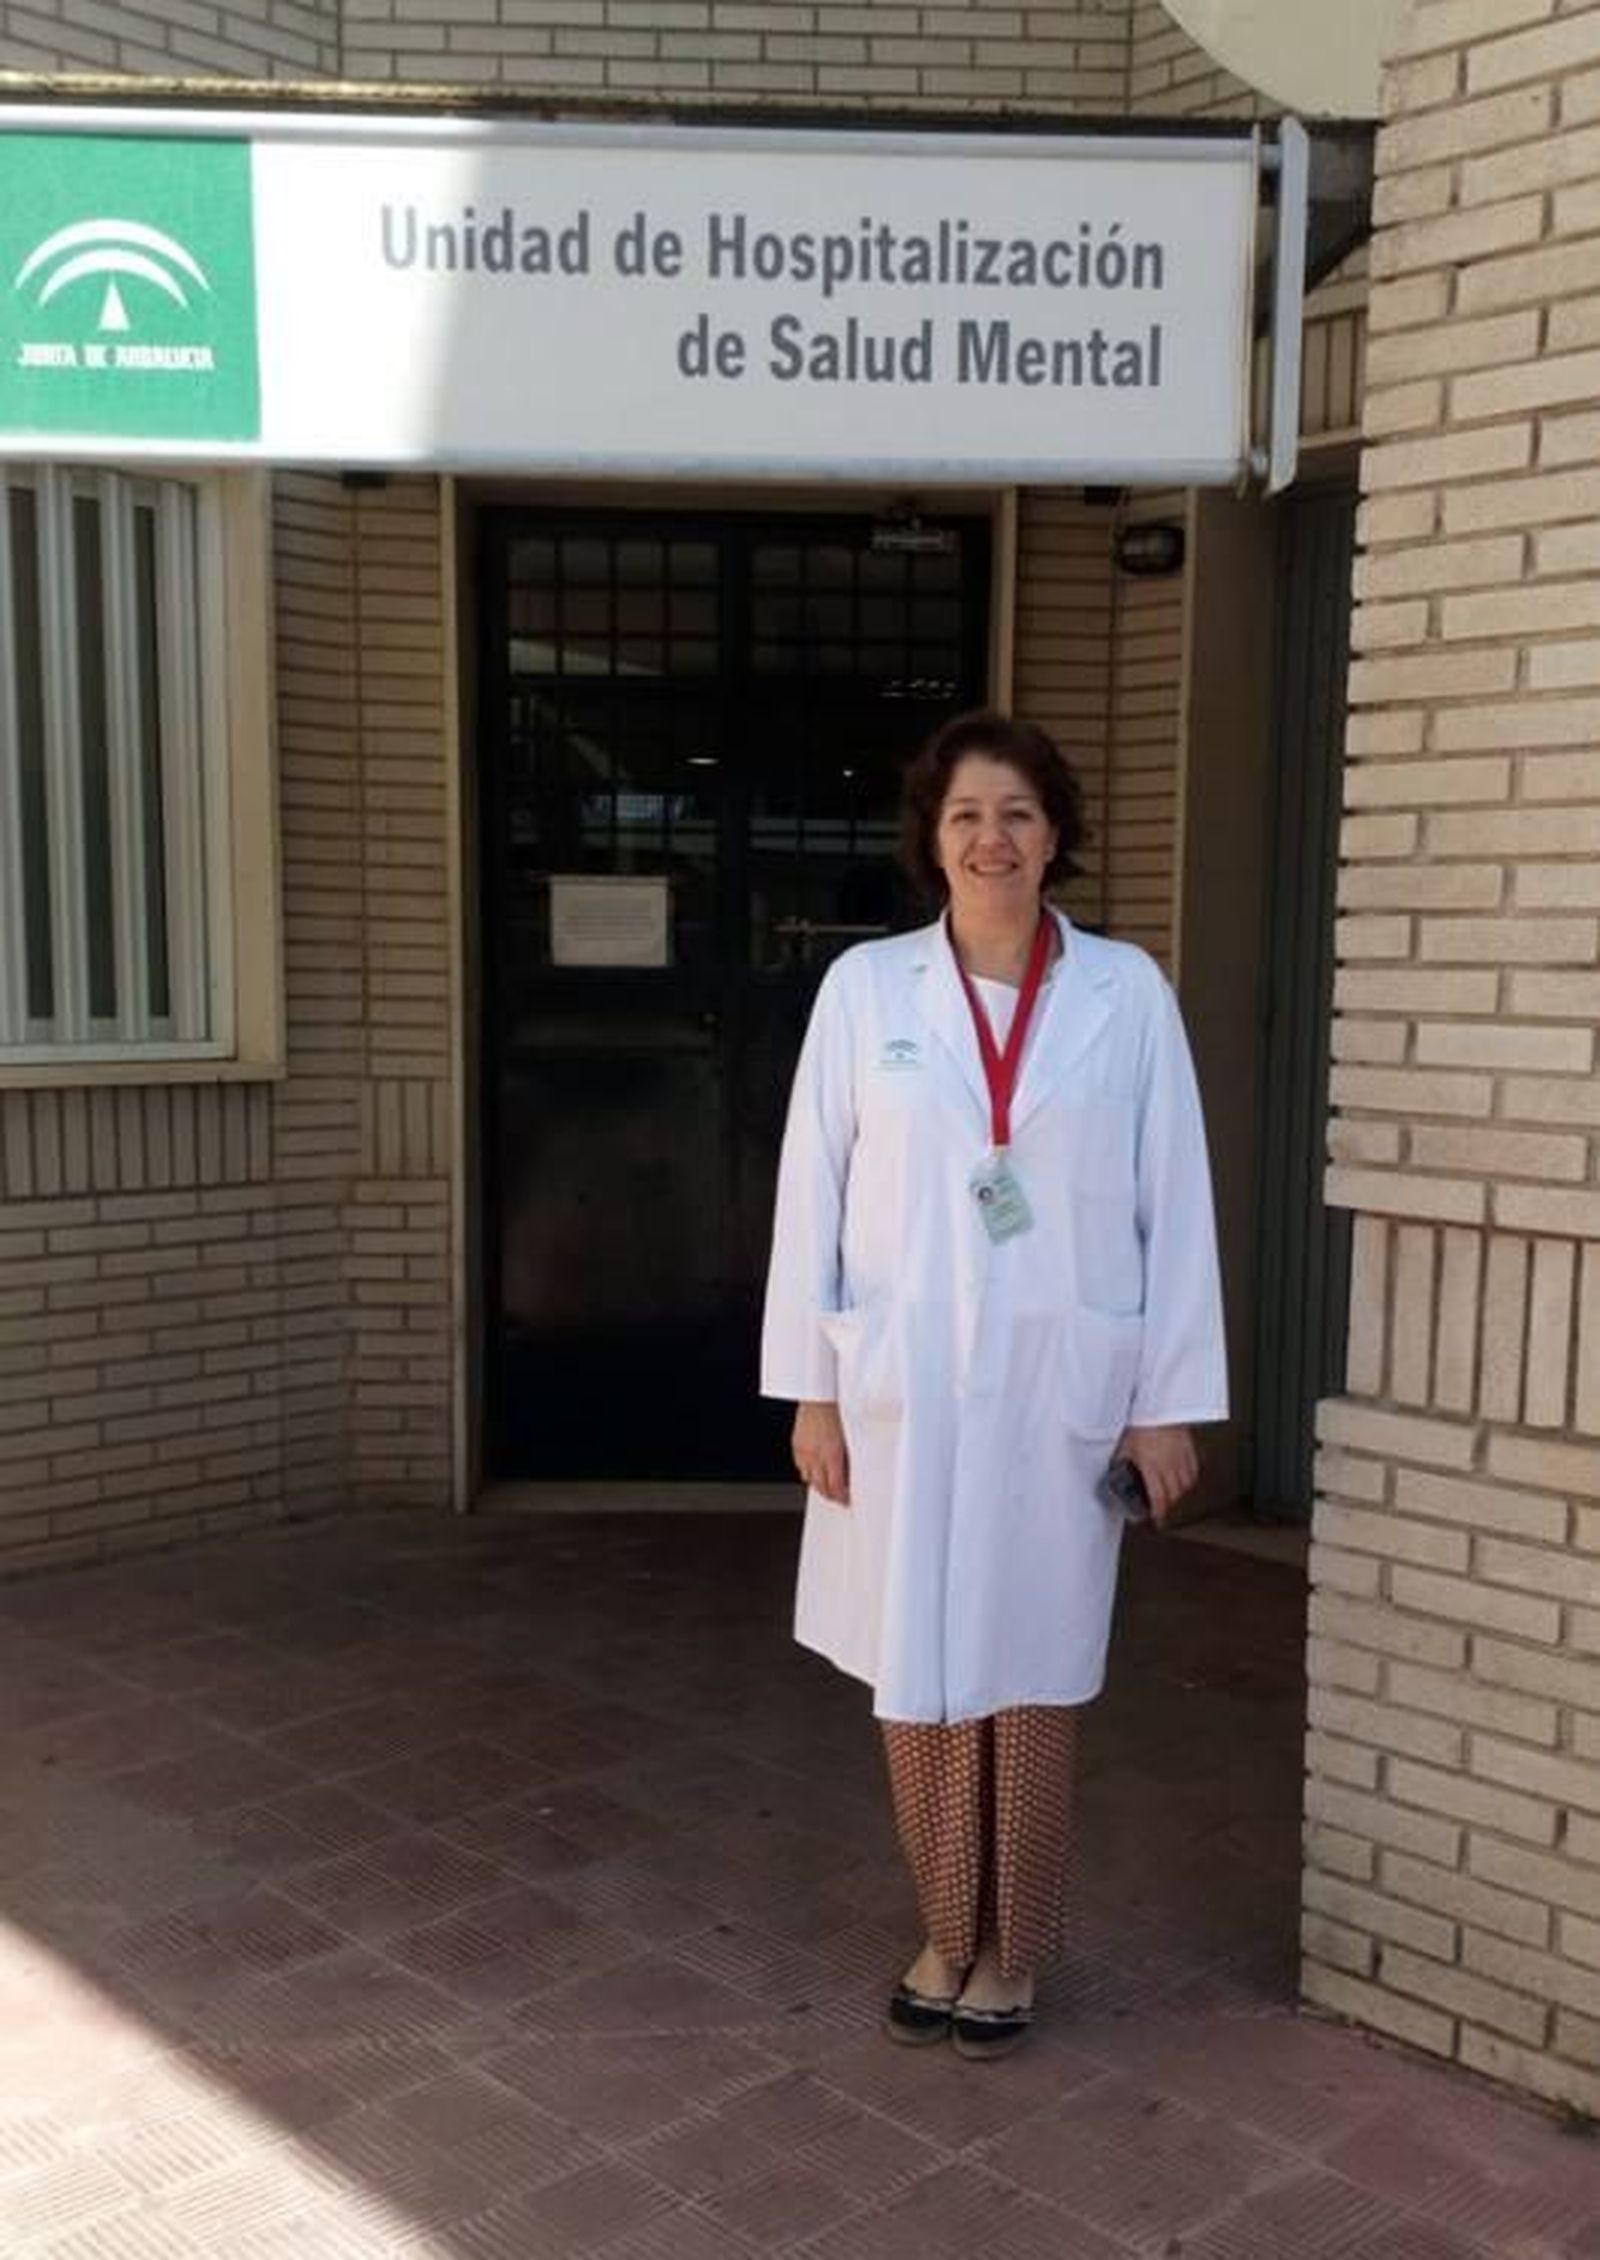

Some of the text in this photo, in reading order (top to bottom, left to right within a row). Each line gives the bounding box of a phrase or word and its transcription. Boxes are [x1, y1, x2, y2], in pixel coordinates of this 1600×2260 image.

[380, 204, 1165, 299] Unidad de Hospitalización
[676, 312, 1163, 388] de Salud Mental
